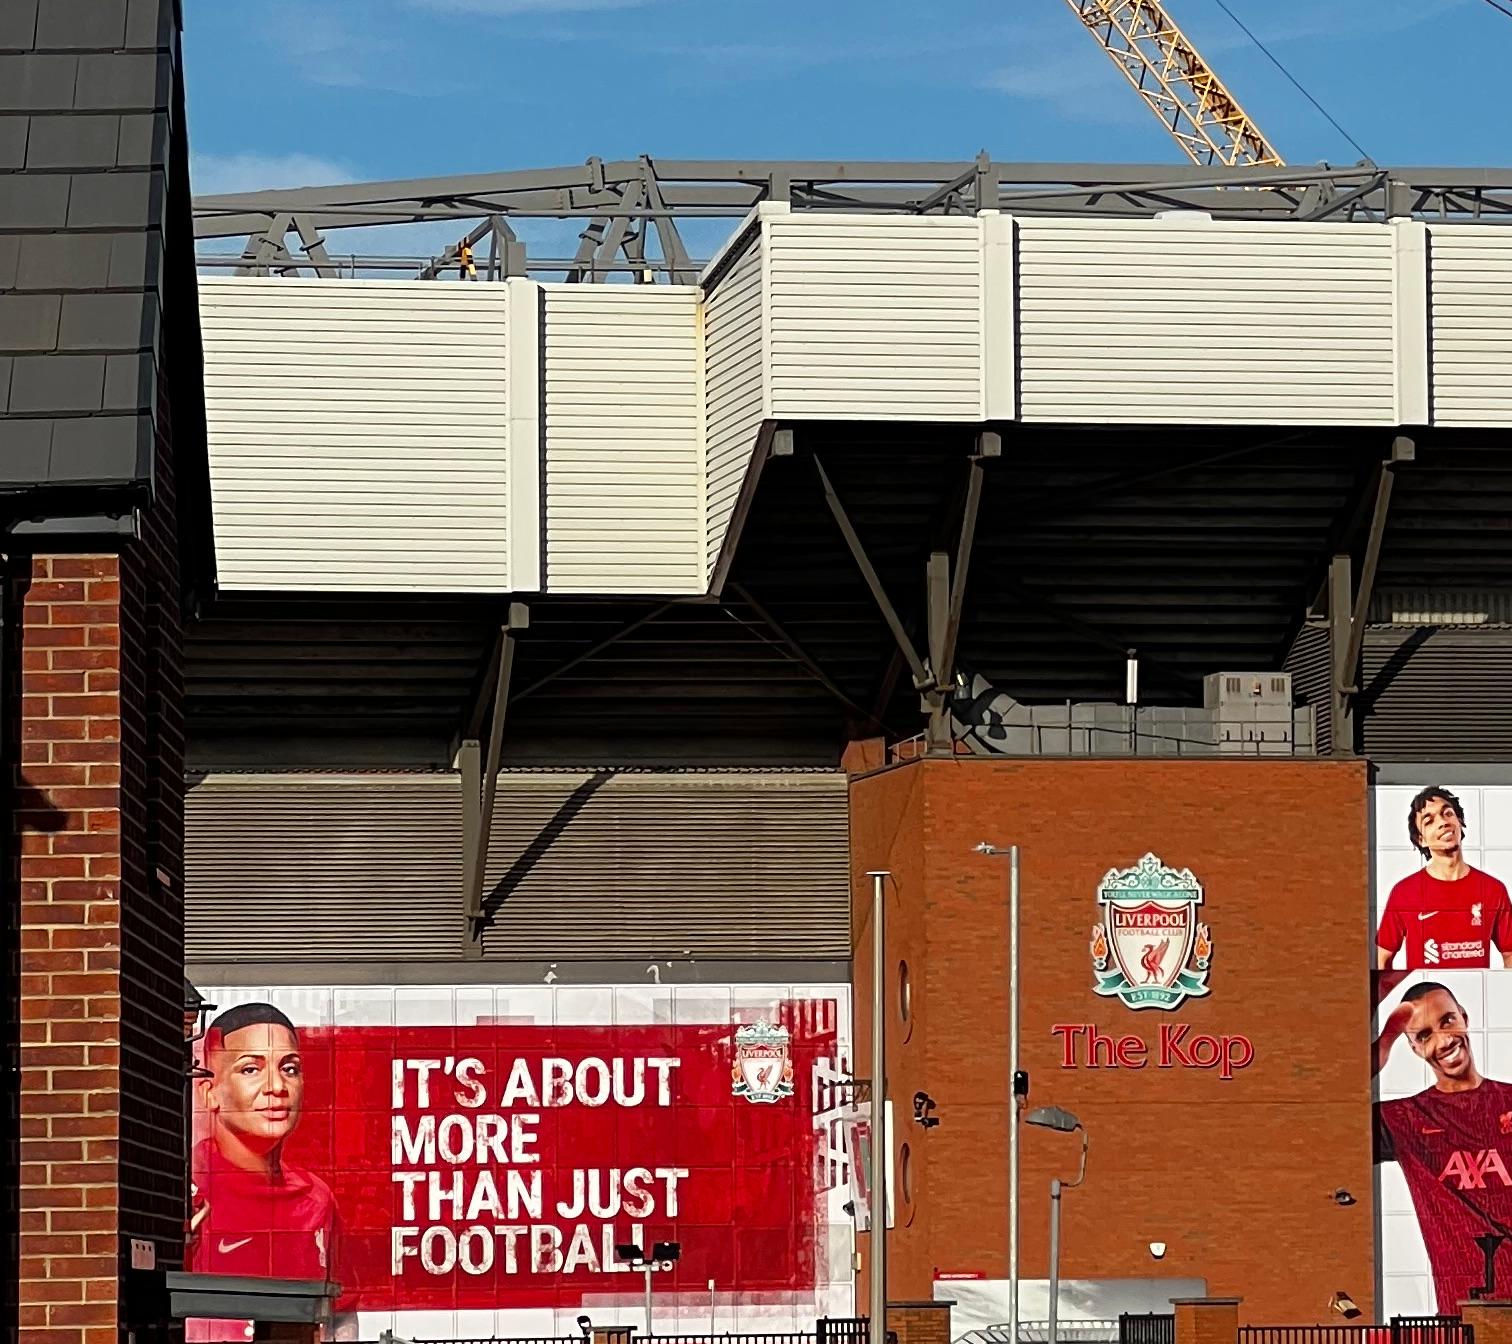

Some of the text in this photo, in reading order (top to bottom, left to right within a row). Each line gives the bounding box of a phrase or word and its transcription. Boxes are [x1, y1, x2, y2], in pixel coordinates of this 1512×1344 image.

[1115, 913, 1187, 927] LIVERPOOL
[1118, 928, 1158, 937] FOOTBALL
[1052, 1023, 1255, 1080] The Kop
[391, 1057, 681, 1109] IT'S ABOUT
[391, 1113, 540, 1165] MORE
[391, 1167, 689, 1221] THAN JUST
